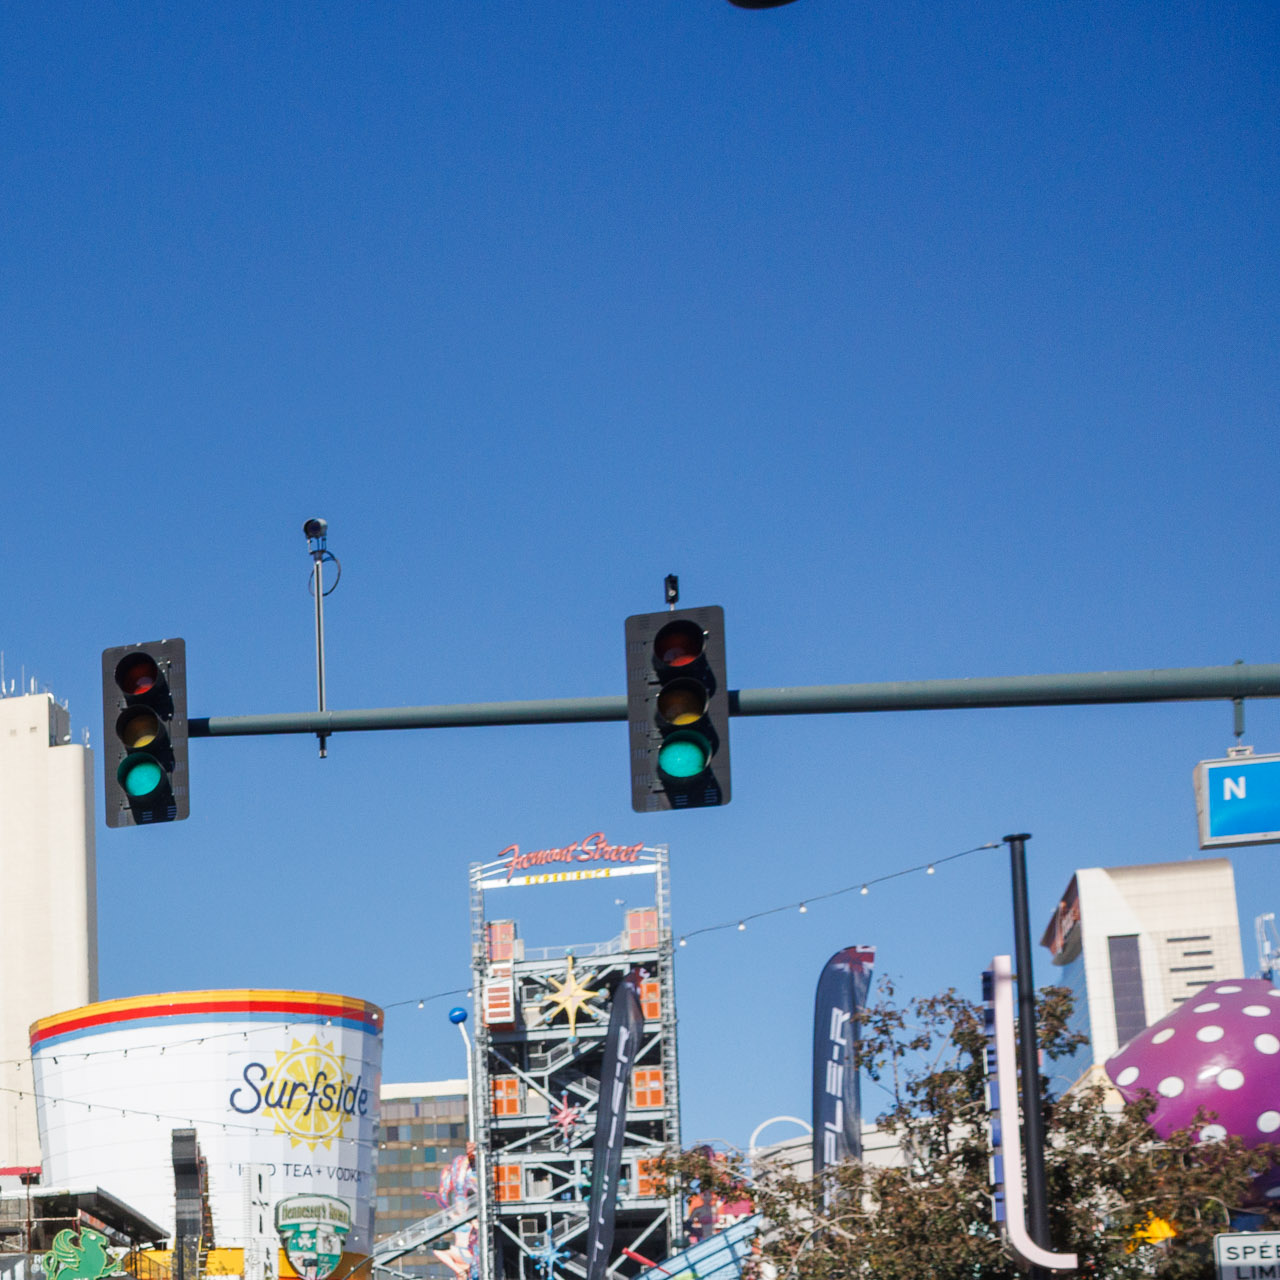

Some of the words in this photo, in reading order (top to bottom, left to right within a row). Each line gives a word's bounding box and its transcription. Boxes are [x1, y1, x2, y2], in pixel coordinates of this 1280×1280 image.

[1223, 775, 1246, 801] N
[576, 831, 644, 864] Street
[525, 867, 611, 885] EXPERIENCE
[230, 1062, 368, 1116] Surfside
[283, 1163, 313, 1177] TEA
[327, 1165, 362, 1183] VODKA
